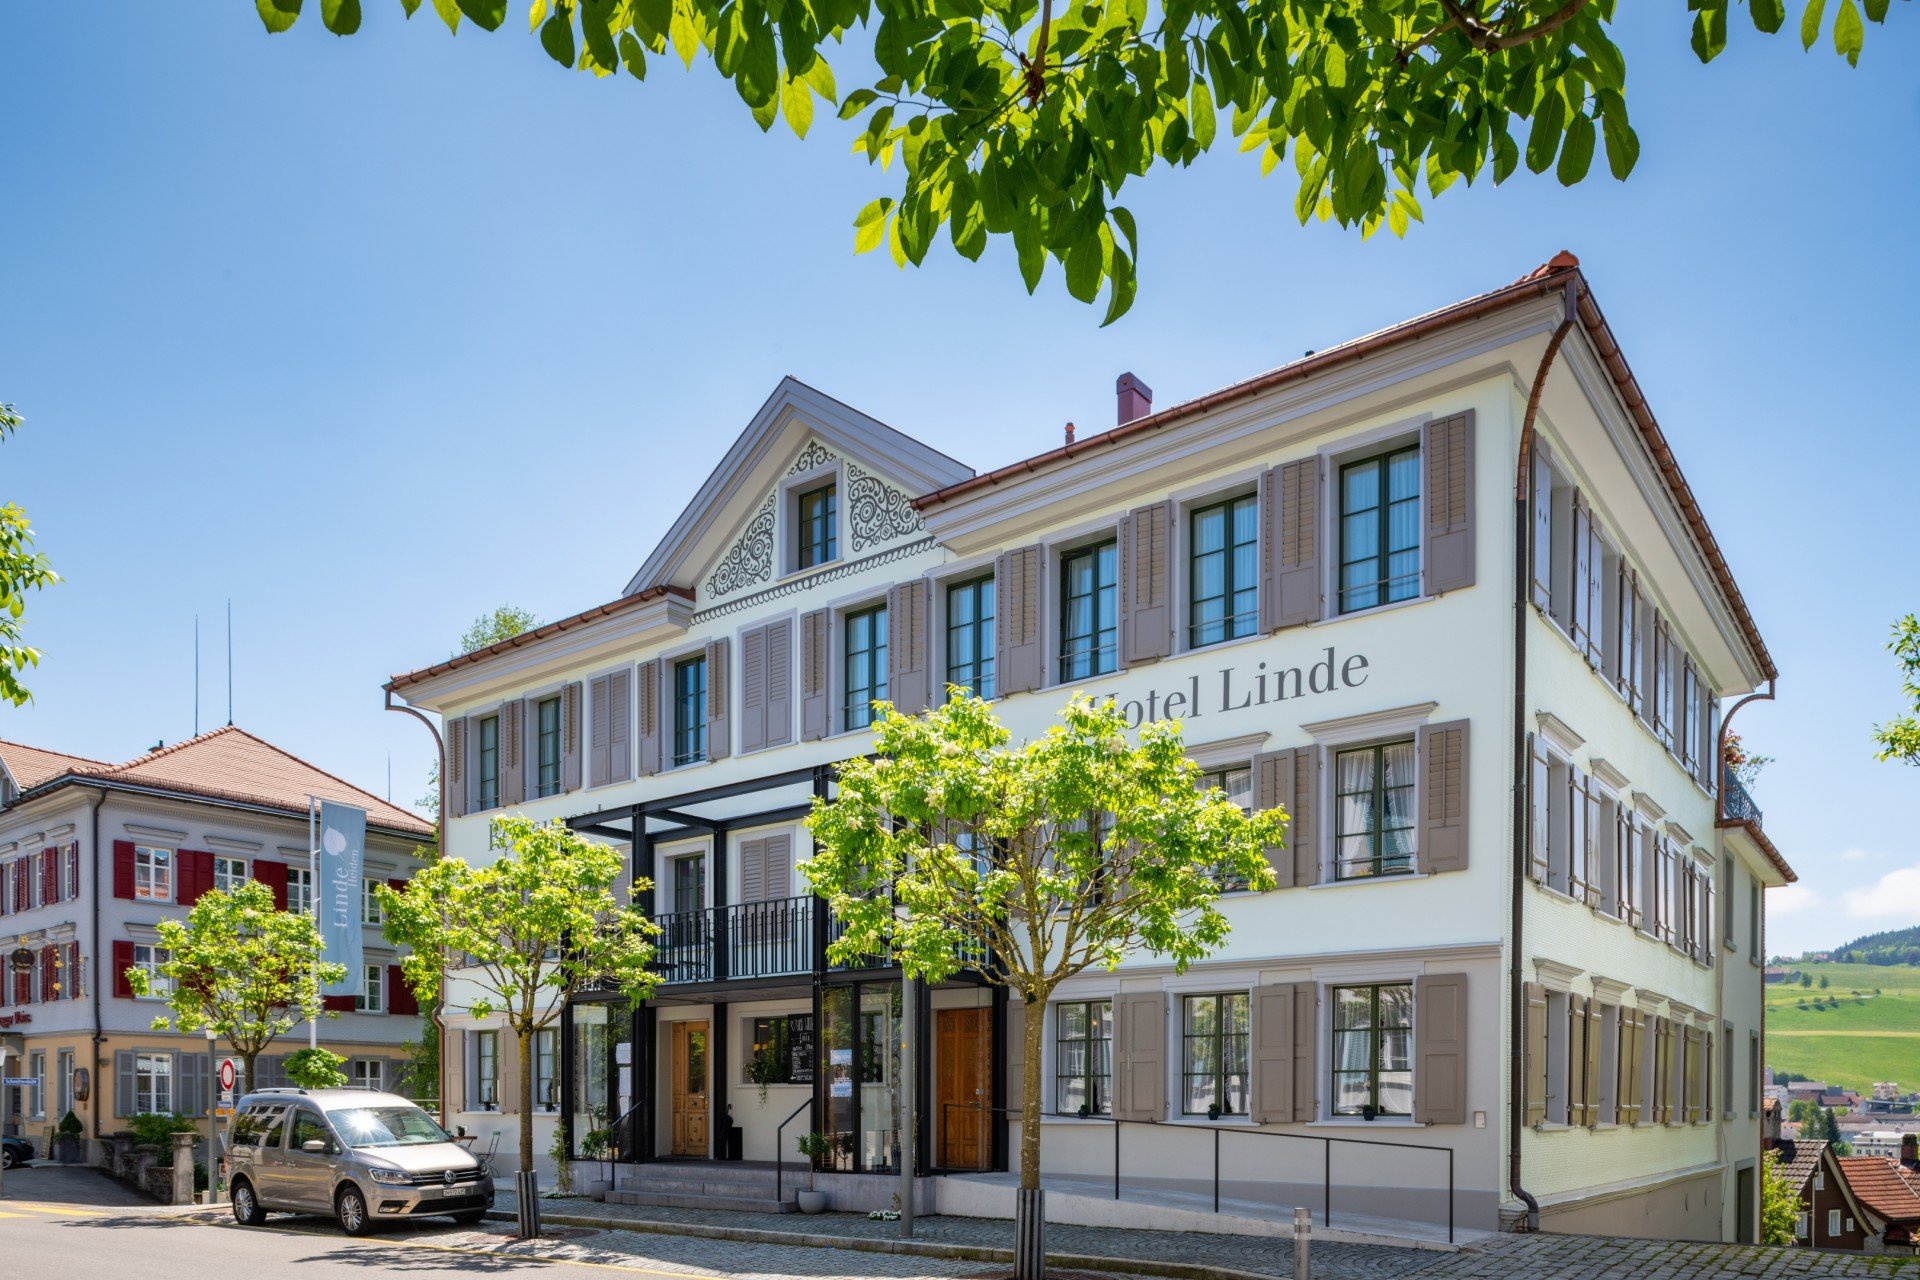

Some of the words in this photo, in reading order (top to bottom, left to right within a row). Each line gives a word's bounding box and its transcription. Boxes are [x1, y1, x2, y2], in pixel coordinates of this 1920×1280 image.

[1218, 646, 1369, 713] Linde
[333, 867, 348, 928] Linde
[347, 849, 359, 888] Heiden
